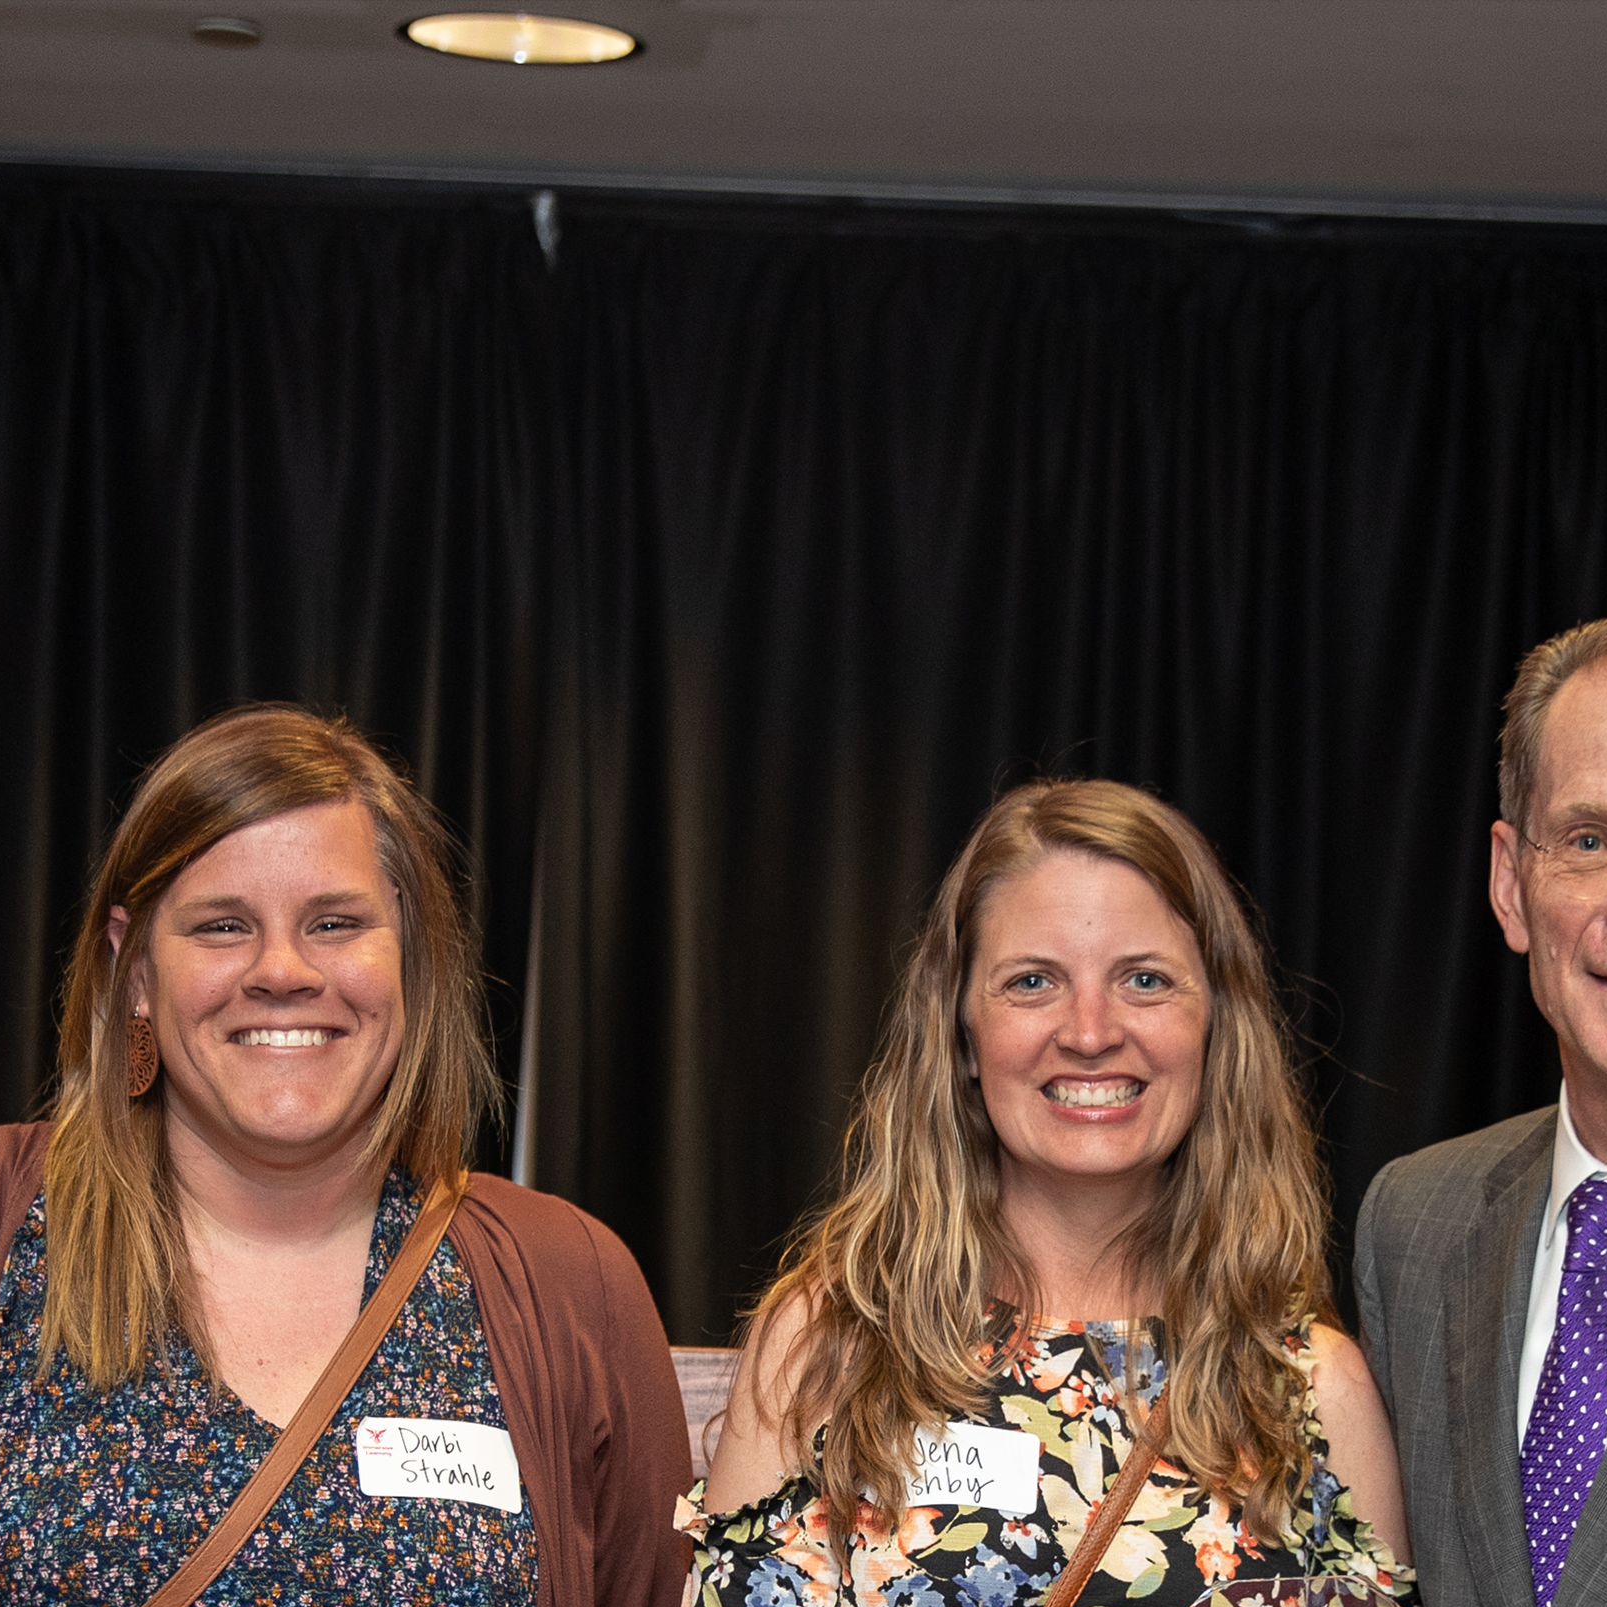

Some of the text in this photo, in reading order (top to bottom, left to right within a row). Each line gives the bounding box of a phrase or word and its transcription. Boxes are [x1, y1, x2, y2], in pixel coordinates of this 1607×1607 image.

[398, 1427, 462, 1454] Darbi
[912, 1437, 983, 1470] Jena
[401, 1459, 495, 1491] Strahle
